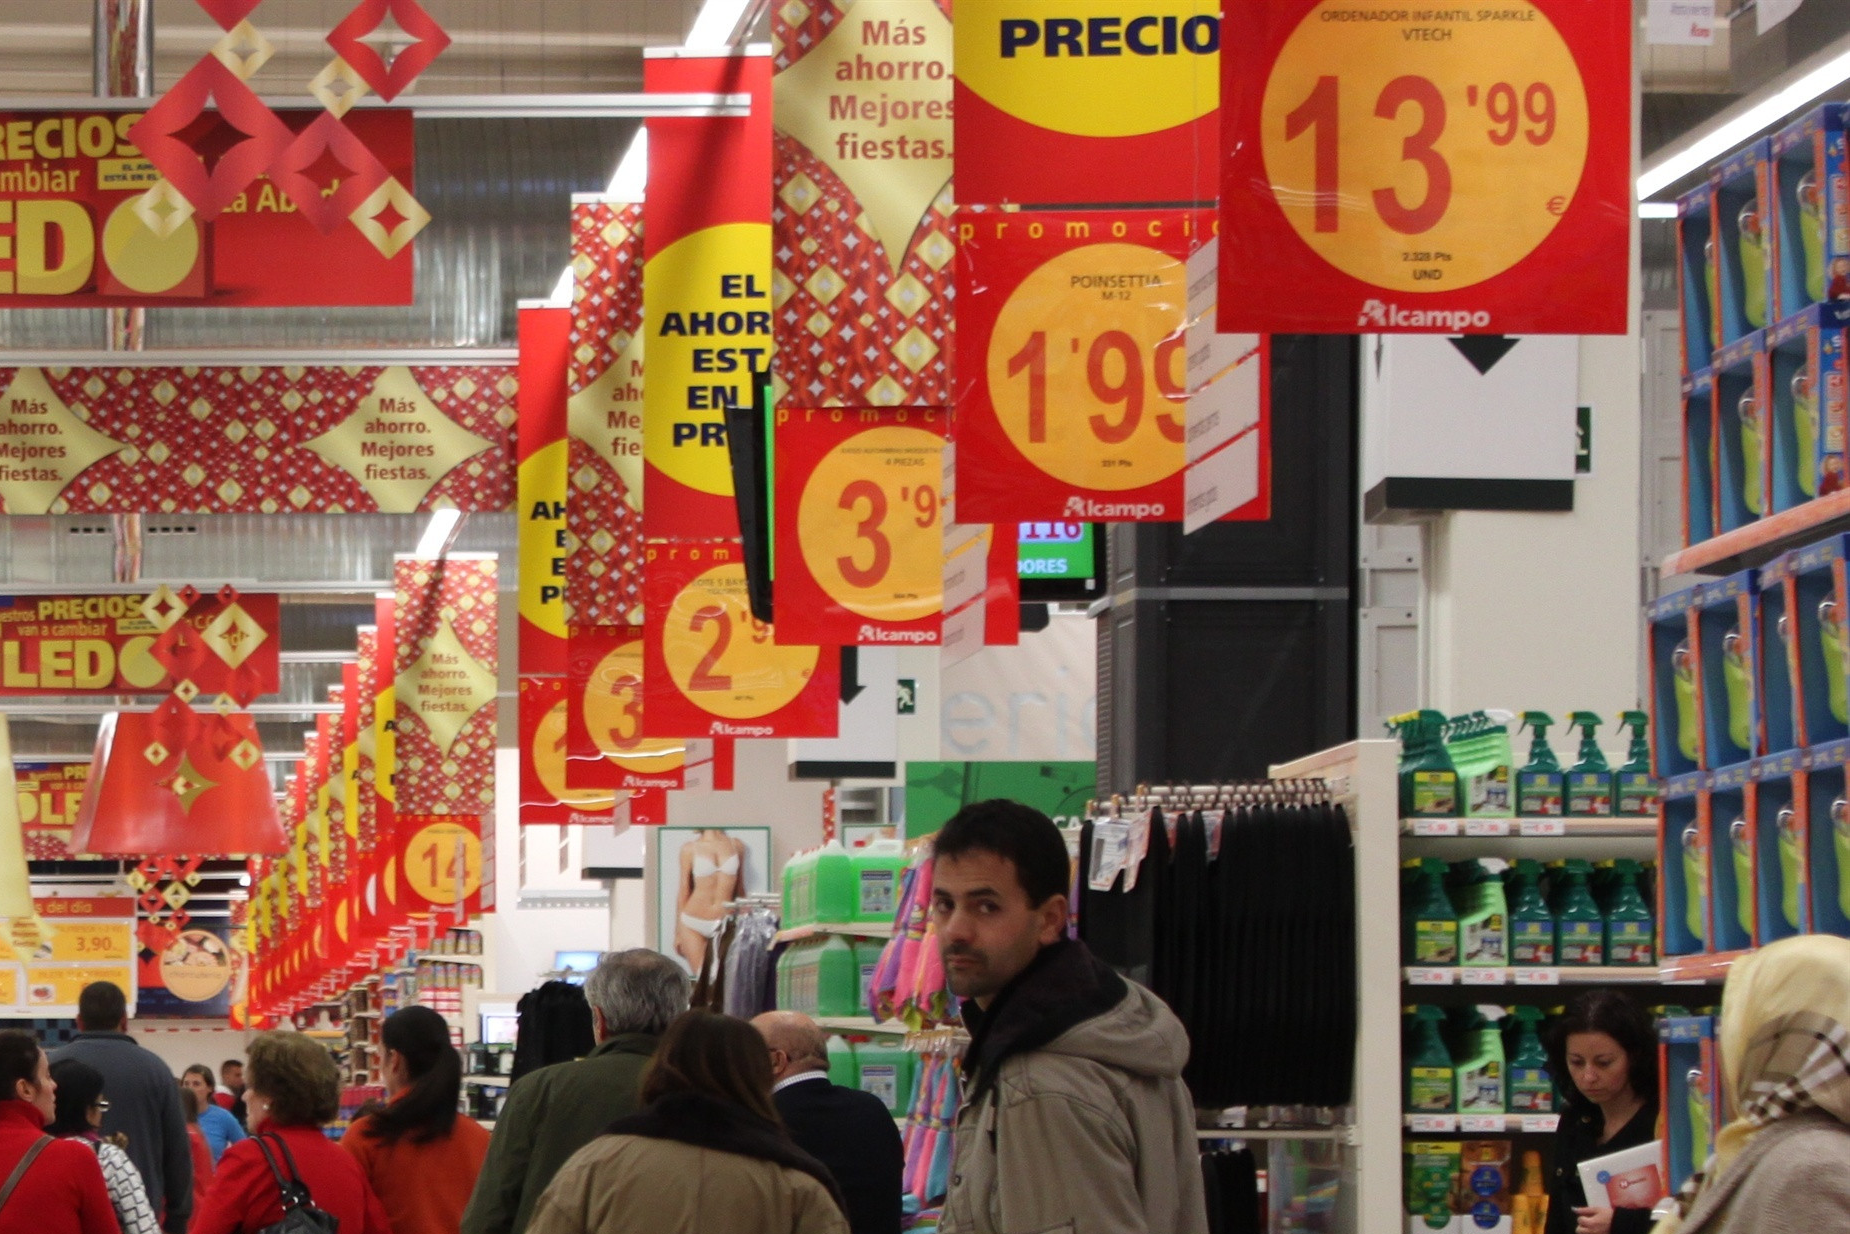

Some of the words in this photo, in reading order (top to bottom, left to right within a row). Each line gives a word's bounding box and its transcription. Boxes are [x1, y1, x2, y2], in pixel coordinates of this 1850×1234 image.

[1320, 9, 1407, 22] ORDENADOR
[1411, 9, 1473, 22] INFANTIL
[1476, 8, 1535, 22] SPARKLE
[862, 18, 925, 45] Más
[1000, 15, 1220, 58] PRECIO
[1402, 28, 1453, 42] VTECH
[836, 55, 953, 81] ahorro.
[836, 133, 953, 160] fiestas.
[1284, 75, 1557, 236] 13'99
[1069, 274, 1162, 289] POINSETTIA
[1412, 269, 1443, 282] UND
[721, 274, 766, 299] EL
[1101, 290, 1132, 301] M-12
[659, 312, 771, 337] AHOR
[1358, 299, 1490, 332] Alcampo
[10, 397, 48, 415] Más
[379, 396, 416, 414] Más
[363, 417, 430, 435] ahorro.
[360, 440, 435, 462] Mejores
[364, 462, 431, 482] fiestas.
[1063, 496, 1164, 519] Alcampo
[50, 621, 107, 637] cambiar
[857, 624, 938, 643] Alcampo
[431, 652, 459, 666] Más
[419, 668, 470, 680] ahorro.
[417, 682, 473, 698] Mejores
[420, 699, 470, 713] fiestas.
[709, 721, 774, 738] Alcampo
[421, 842, 471, 888] 14
